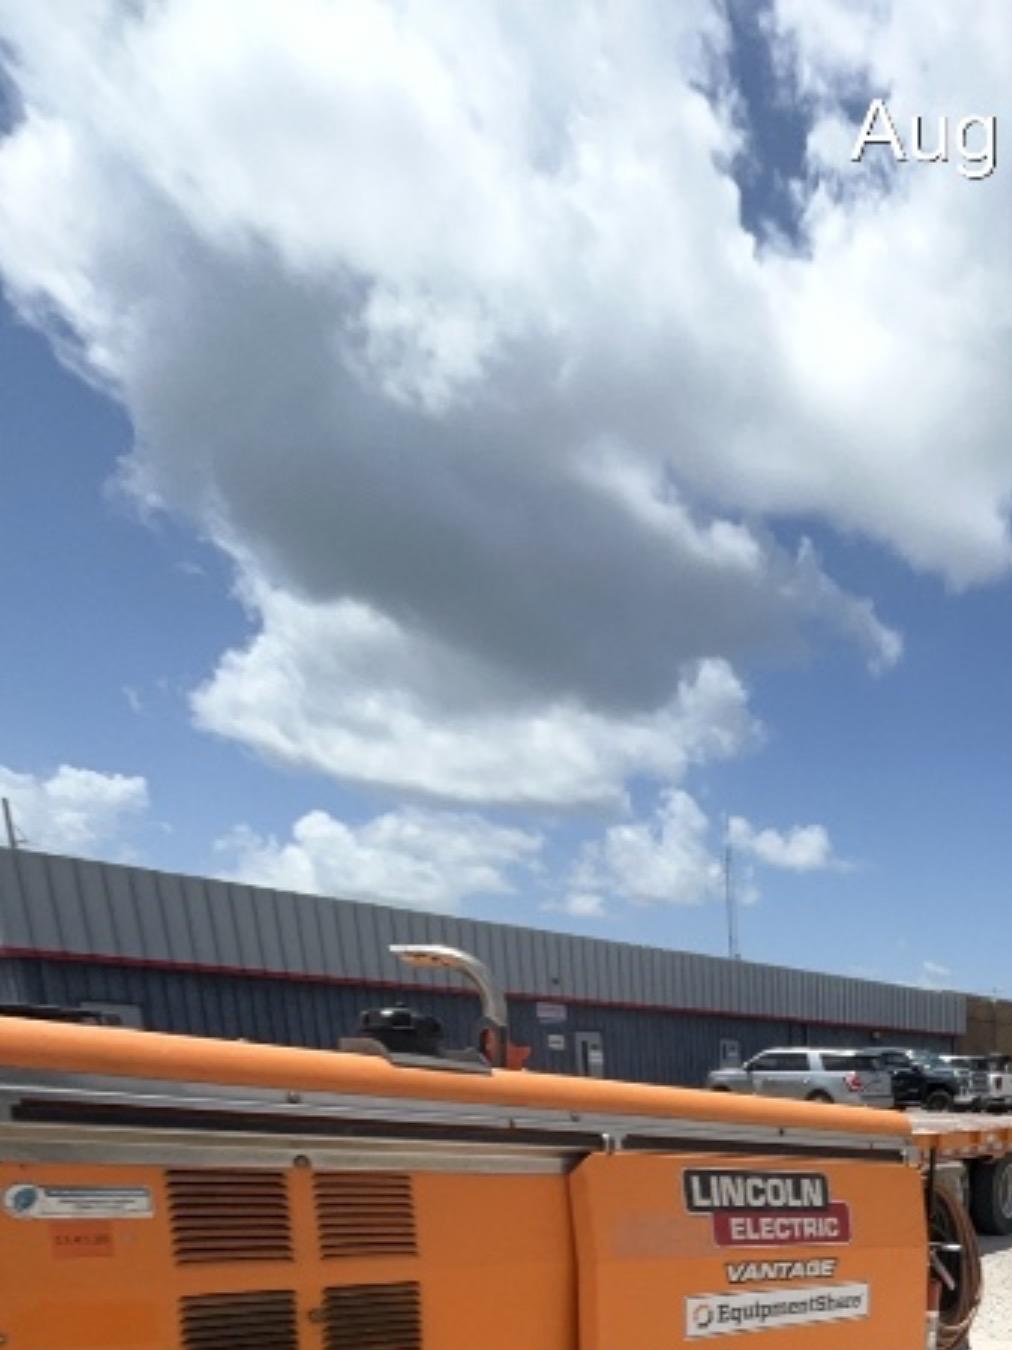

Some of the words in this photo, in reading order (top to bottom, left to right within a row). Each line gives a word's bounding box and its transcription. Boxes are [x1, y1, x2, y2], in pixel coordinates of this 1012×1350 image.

[689, 1175, 824, 1208] LINCOLN
[728, 1216, 840, 1241] ELECTRIC
[723, 1257, 839, 1284] VANTAGE
[716, 1293, 863, 1327] EquipmentShare
